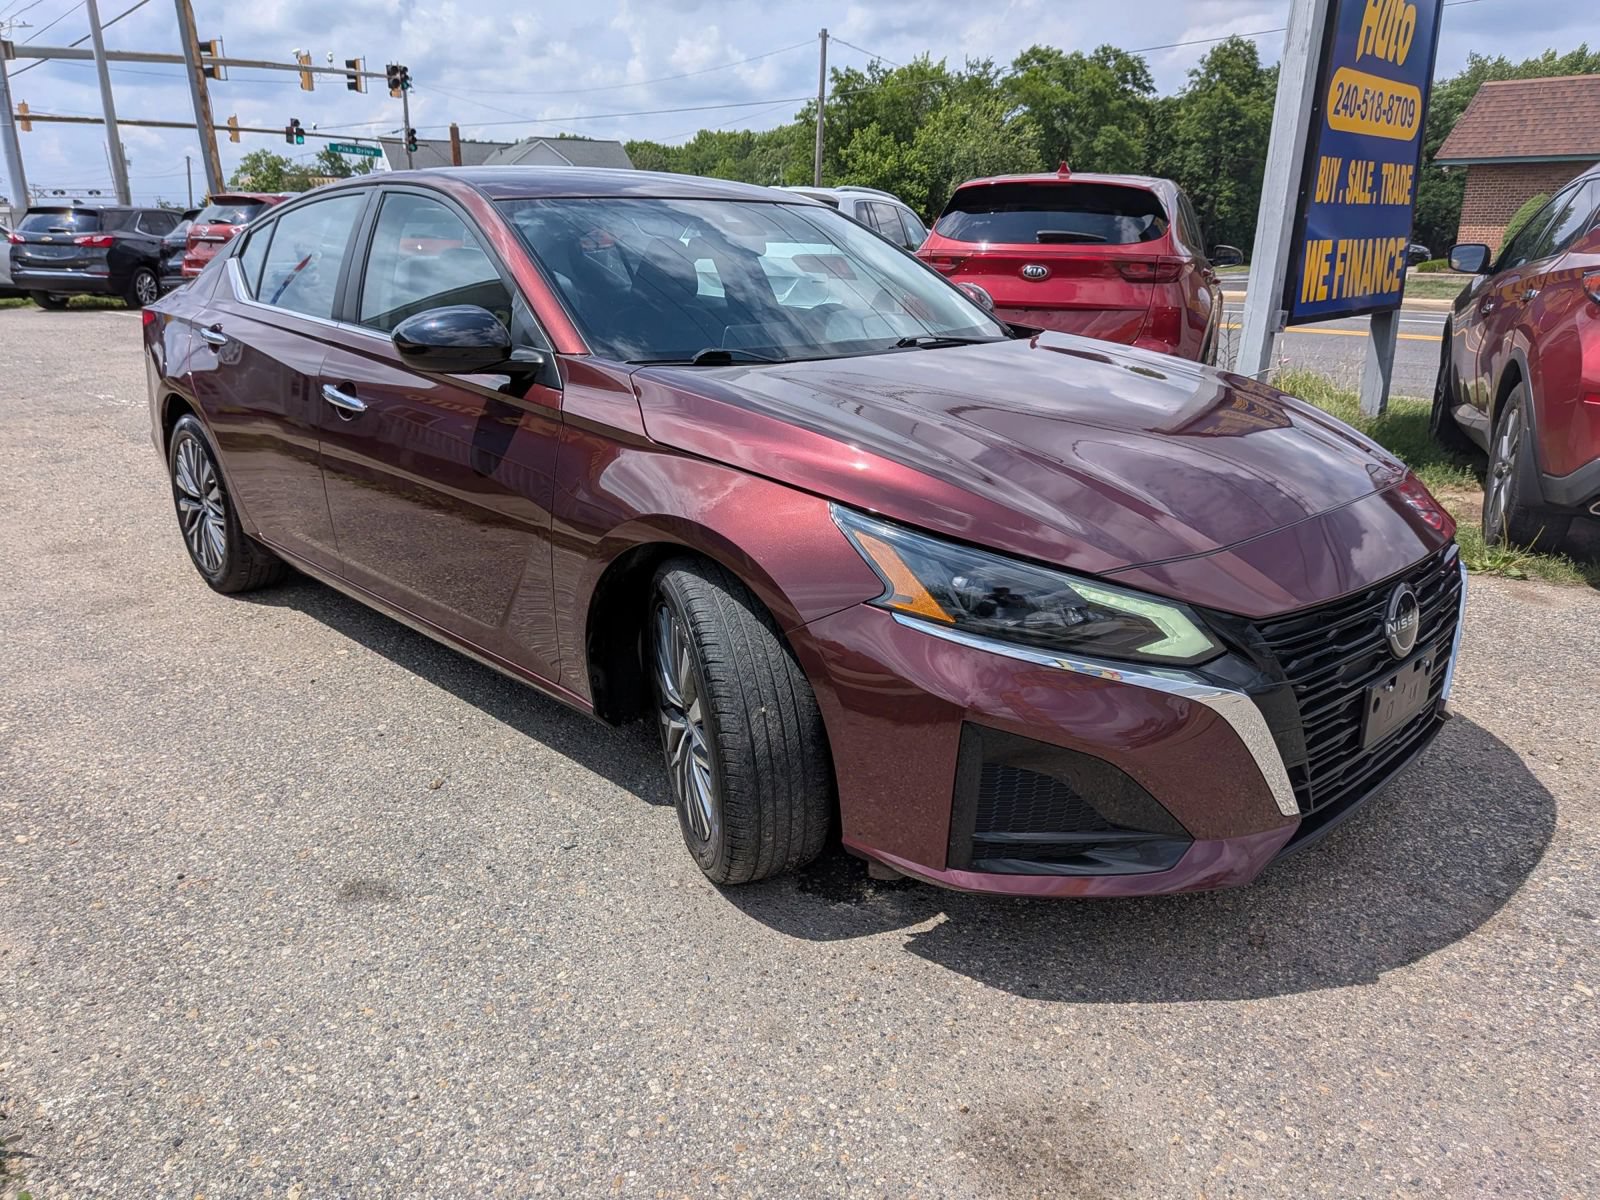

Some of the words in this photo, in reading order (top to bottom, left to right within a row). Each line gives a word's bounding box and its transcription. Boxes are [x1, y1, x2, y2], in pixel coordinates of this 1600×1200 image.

[1355, 0, 1417, 66] Auto
[1333, 82, 1415, 128] 240-518-8709
[1315, 156, 1342, 203] BUY
[1345, 160, 1375, 204] SALE
[1380, 163, 1413, 205] TRADE
[1301, 240, 1333, 304] WE
[1332, 237, 1406, 300] FINANCE
[1387, 612, 1417, 634] NISS
